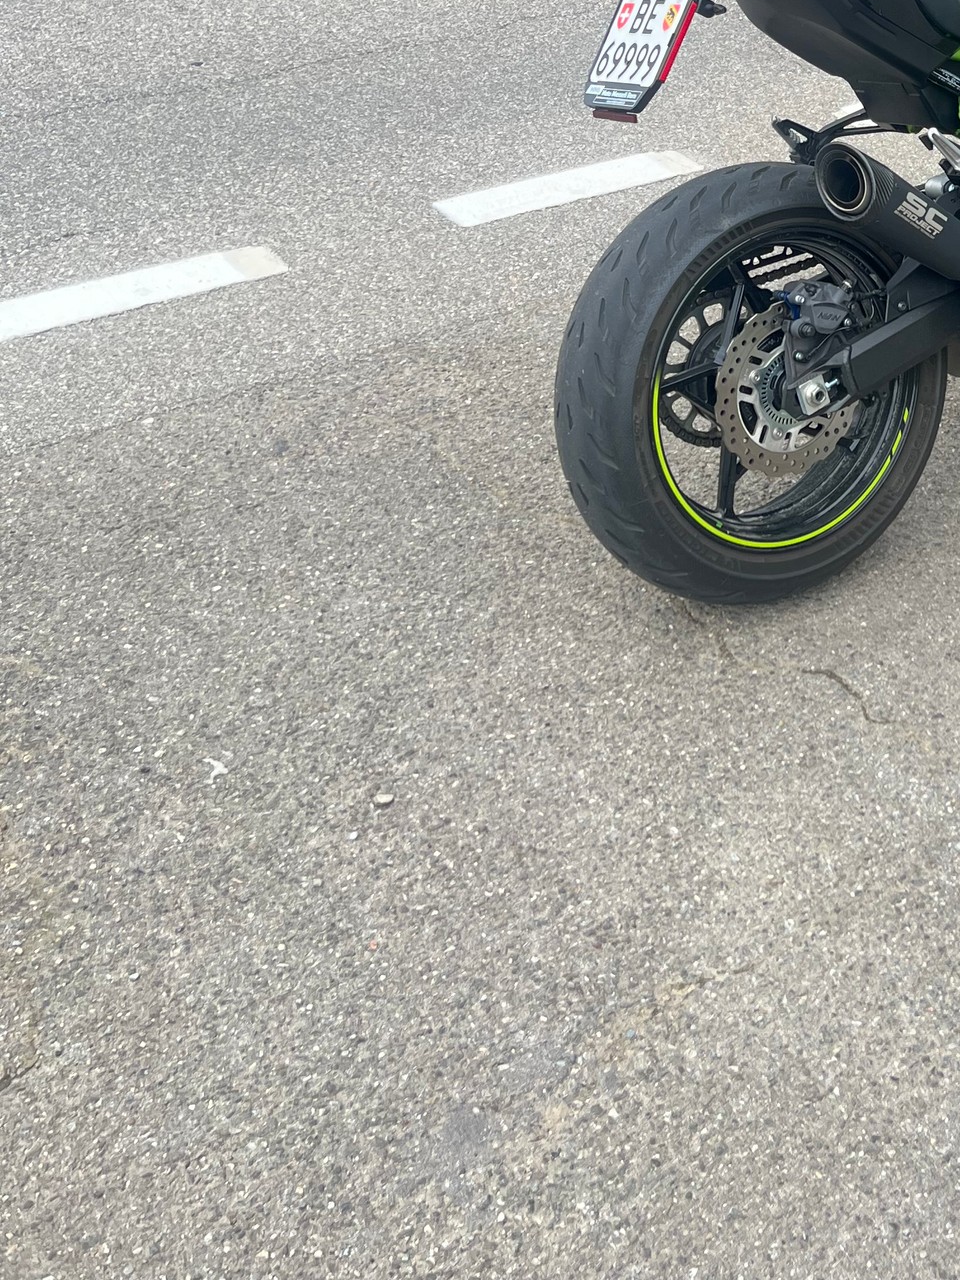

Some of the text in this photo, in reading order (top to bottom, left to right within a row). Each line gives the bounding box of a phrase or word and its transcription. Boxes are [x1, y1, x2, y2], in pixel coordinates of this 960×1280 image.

[629, 0, 666, 35] BE
[596, 41, 661, 82] 69999
[896, 205, 940, 236] PROJECT
[901, 191, 948, 232] SC
